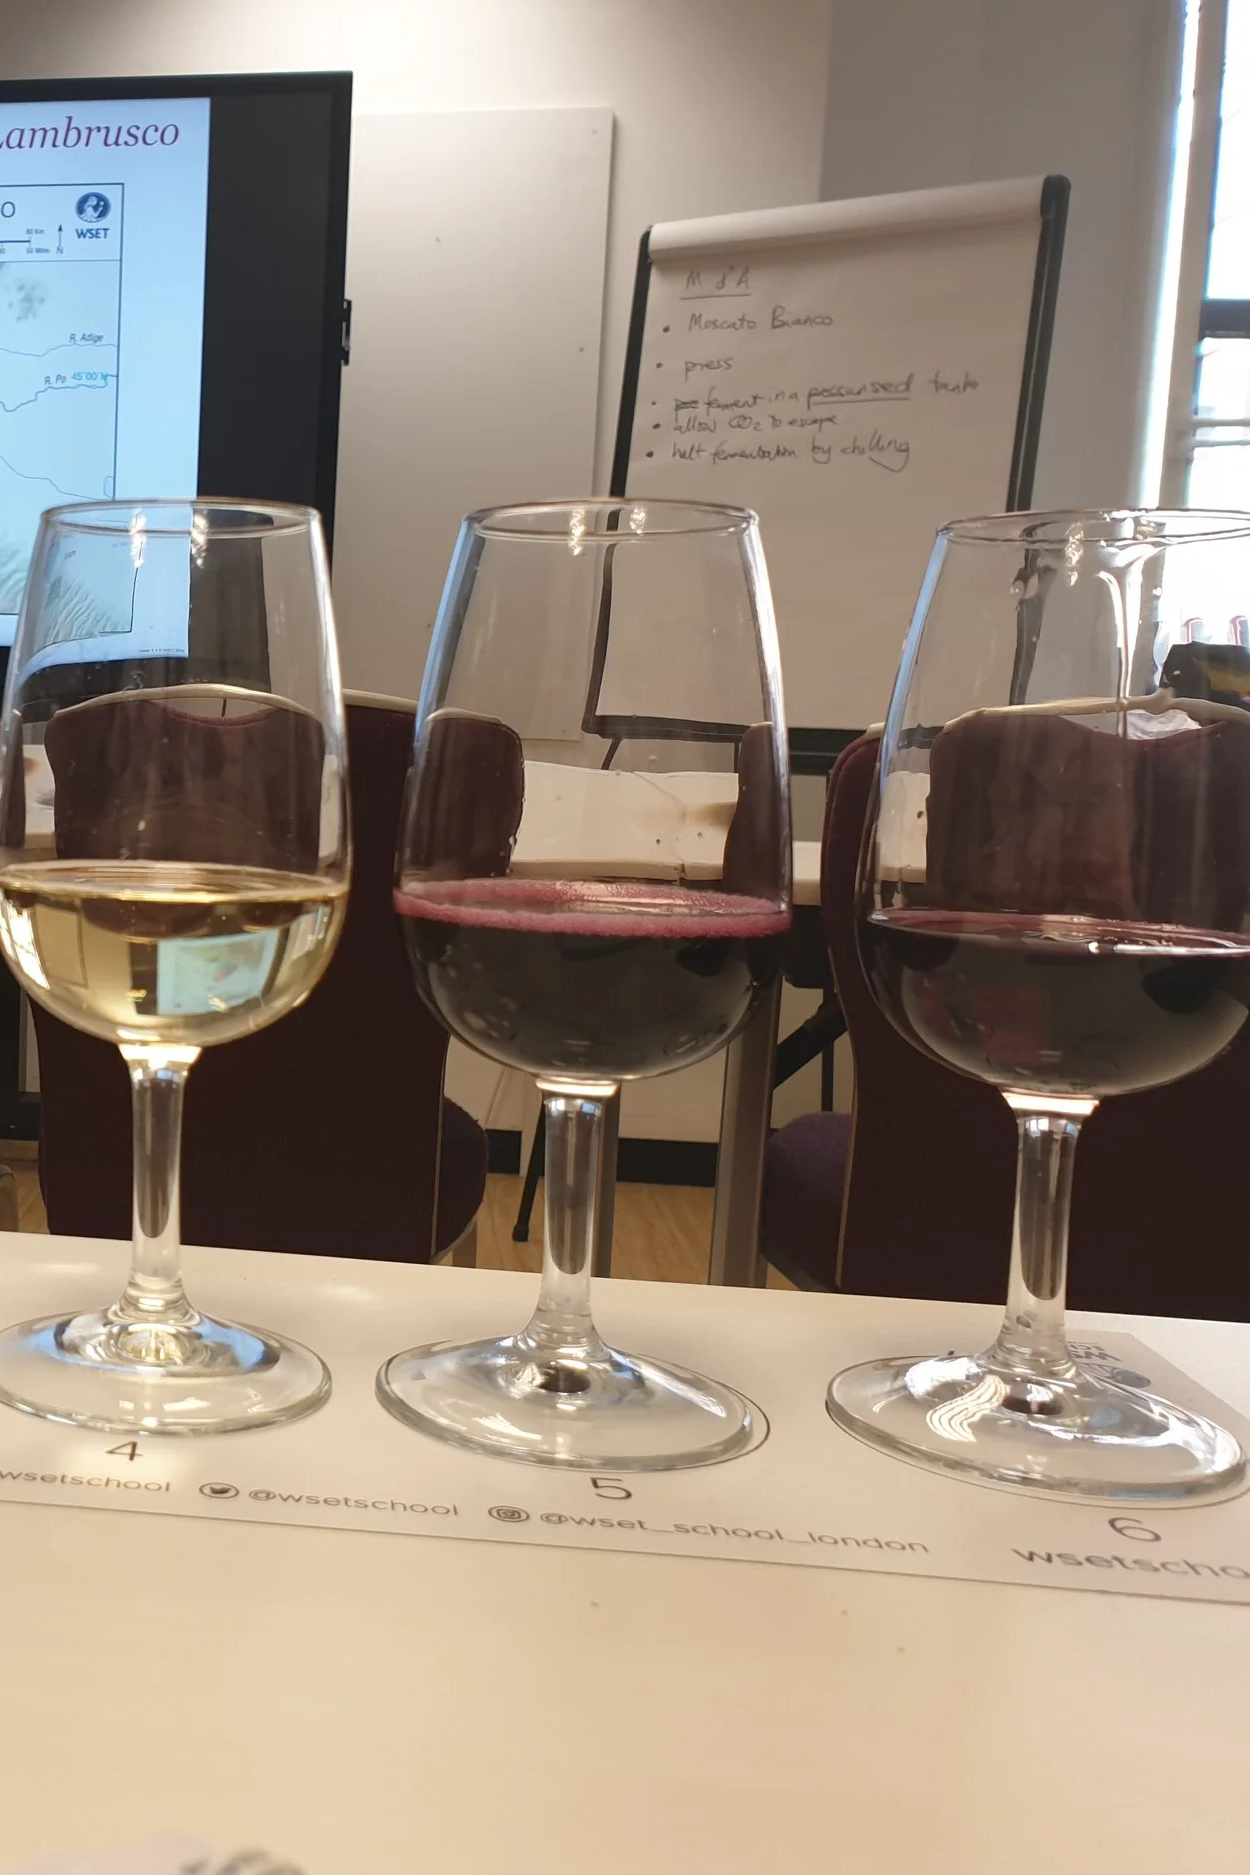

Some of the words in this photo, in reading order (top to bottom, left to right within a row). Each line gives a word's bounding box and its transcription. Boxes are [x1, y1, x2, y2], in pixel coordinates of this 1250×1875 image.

[75, 228, 111, 239] WSET
[688, 312, 757, 332] Moscato
[771, 304, 833, 330] Bianco
[80, 332, 104, 343] Adige
[684, 357, 733, 383] press
[673, 416, 716, 434] allow
[811, 435, 832, 465] by
[104, 1440, 144, 1462] 4
[589, 1476, 633, 1501] 5
[248, 1488, 459, 1516] @wsetschool
[539, 1511, 930, 1554] @wset_school_london
[1107, 1516, 1163, 1543] 6
